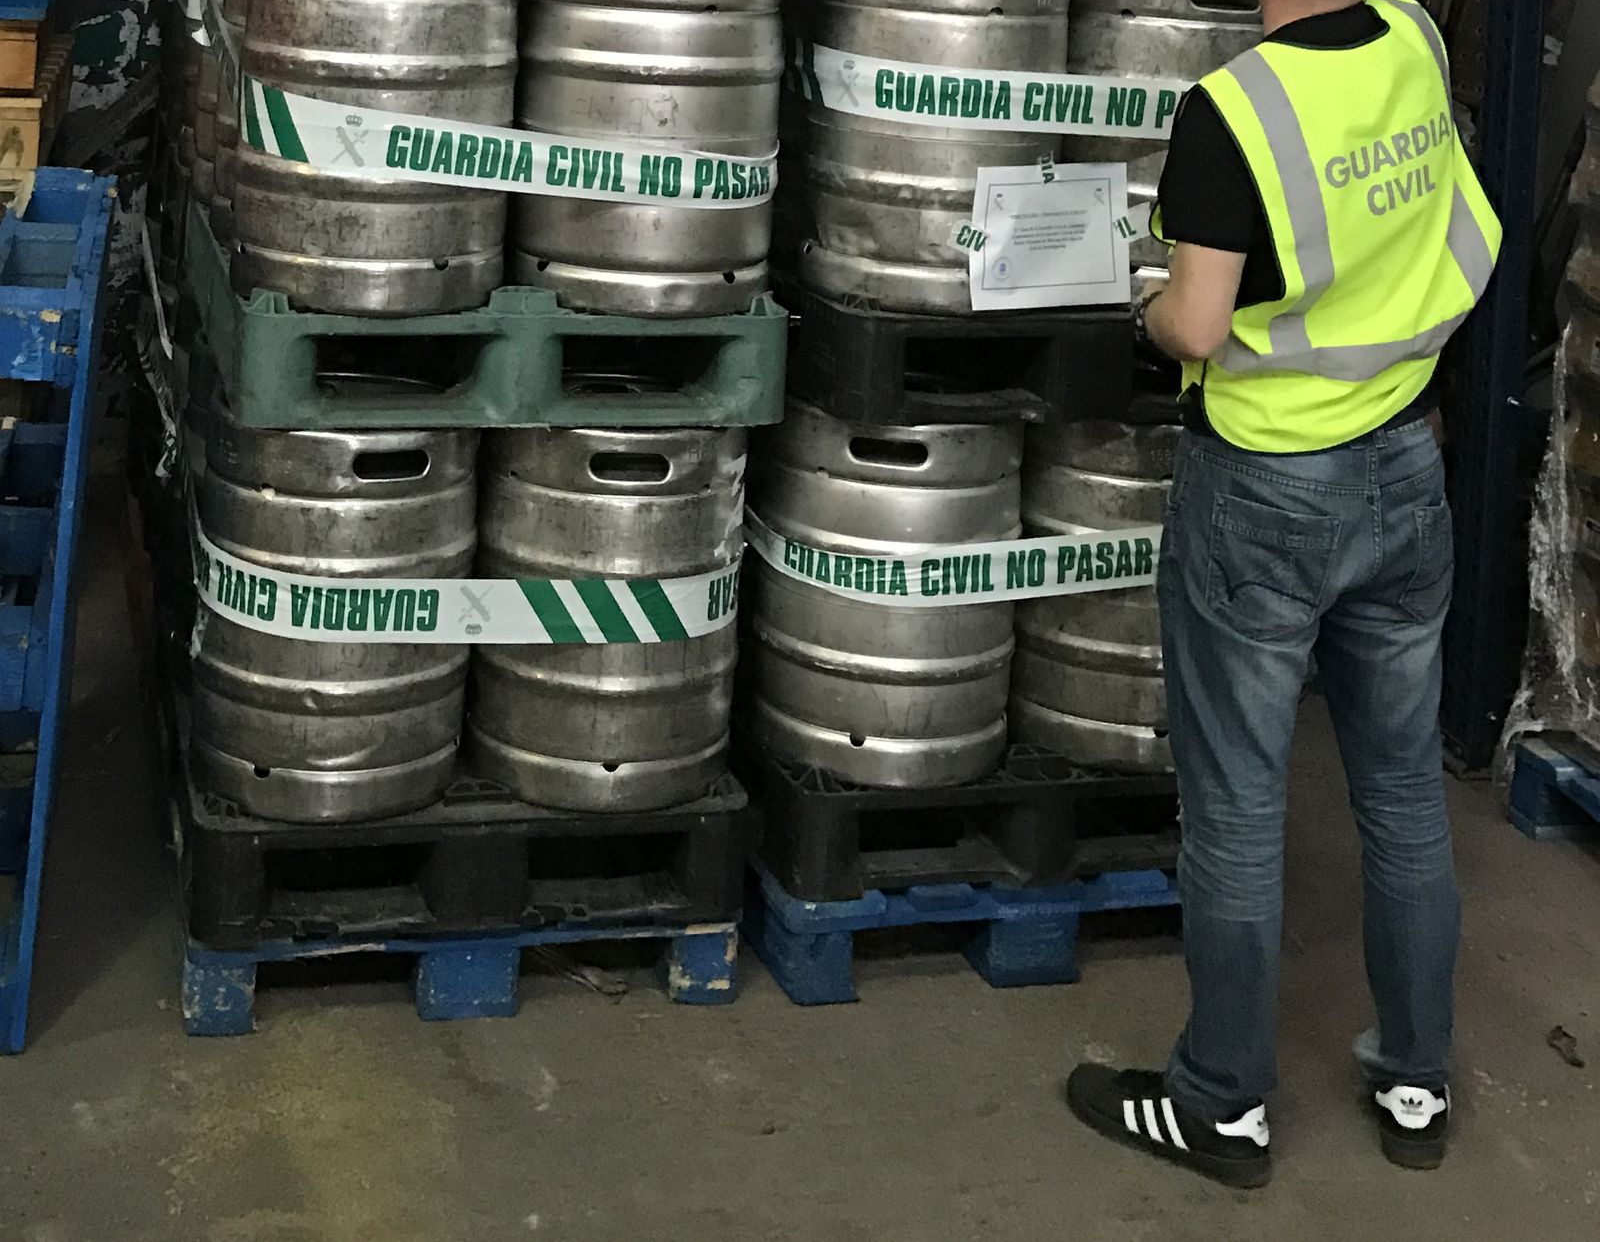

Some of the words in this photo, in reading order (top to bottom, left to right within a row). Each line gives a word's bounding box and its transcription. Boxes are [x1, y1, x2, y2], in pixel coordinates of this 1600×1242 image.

[875, 68, 1011, 121] GUARDIA
[1022, 81, 1094, 124] CIVIL
[1105, 87, 1144, 127] NO
[386, 124, 533, 183] GUARDIA
[546, 146, 626, 193] CIVIL
[638, 154, 683, 198] NO
[692, 159, 772, 201] PASAR
[1325, 111, 1455, 189] GUARDIA
[1366, 165, 1437, 217] CIVIL
[216, 559, 277, 622] CIVIL
[783, 538, 909, 597] GUARDIA
[920, 553, 995, 597] CIVIL
[1006, 548, 1046, 590] NO
[1057, 537, 1154, 584] PASAR
[290, 583, 440, 633] GUARDIA
